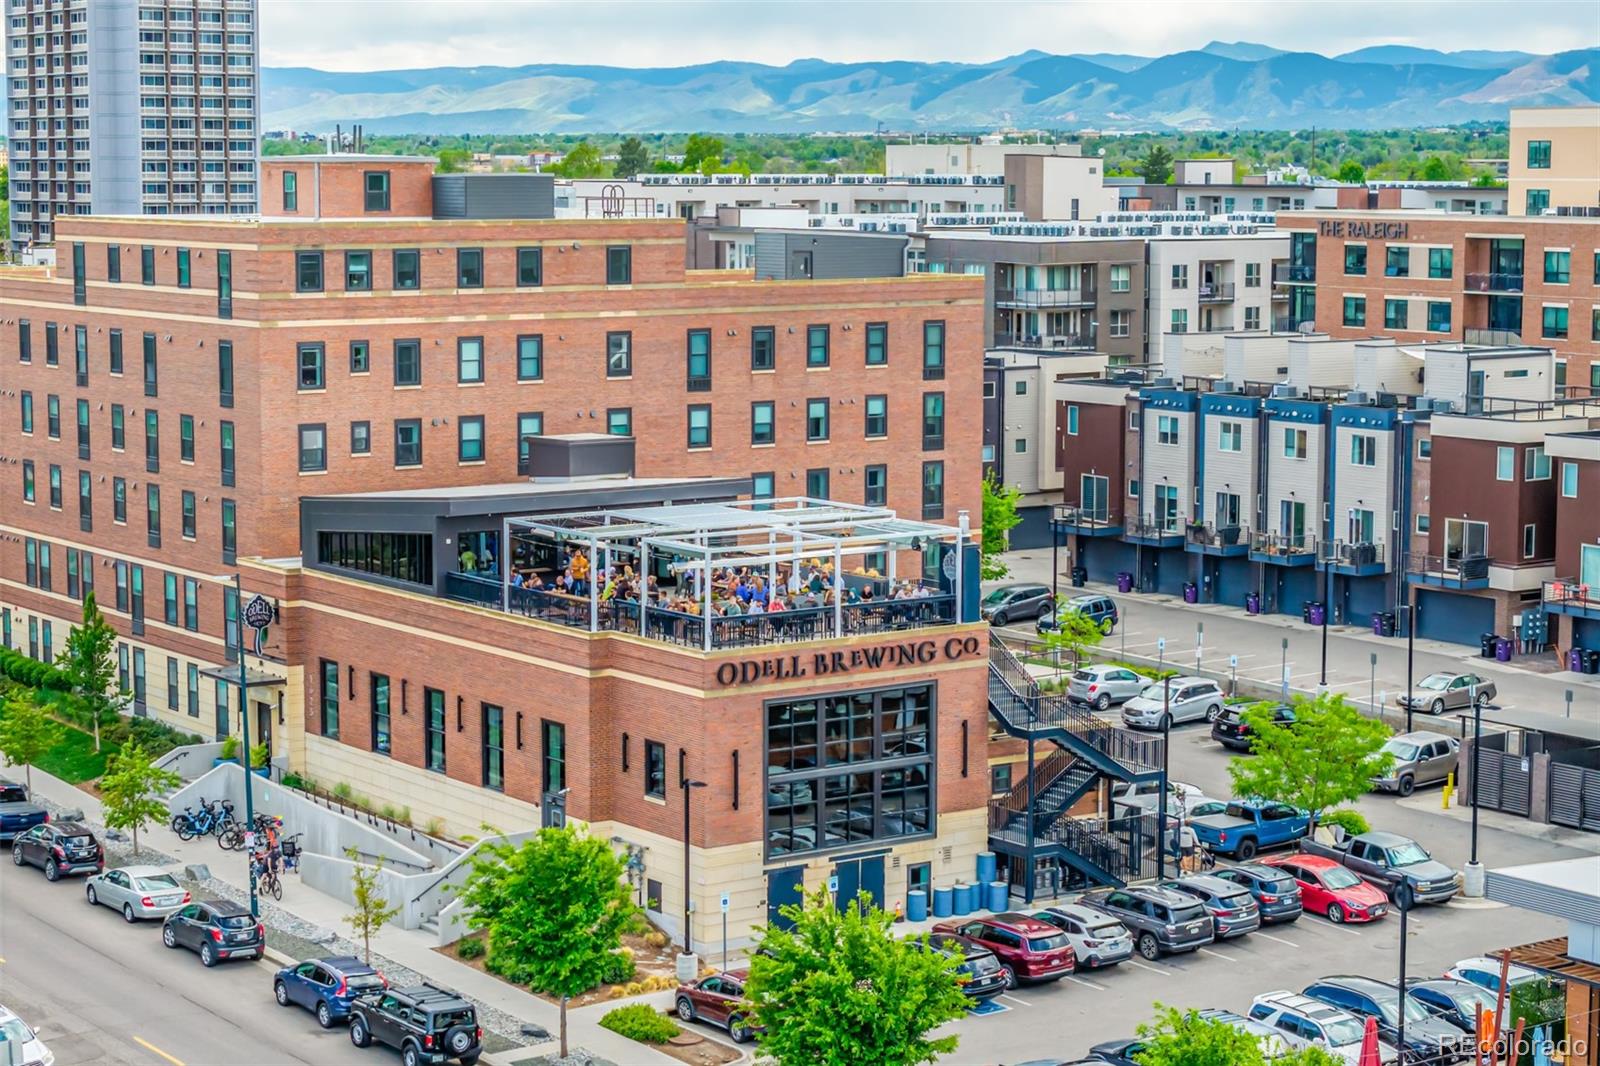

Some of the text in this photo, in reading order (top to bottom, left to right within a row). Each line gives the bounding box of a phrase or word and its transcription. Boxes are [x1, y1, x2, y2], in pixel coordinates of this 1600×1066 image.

[1319, 220, 1408, 239] THE RALEIGH
[716, 655, 806, 686] ODELL
[814, 640, 937, 674] BREWING
